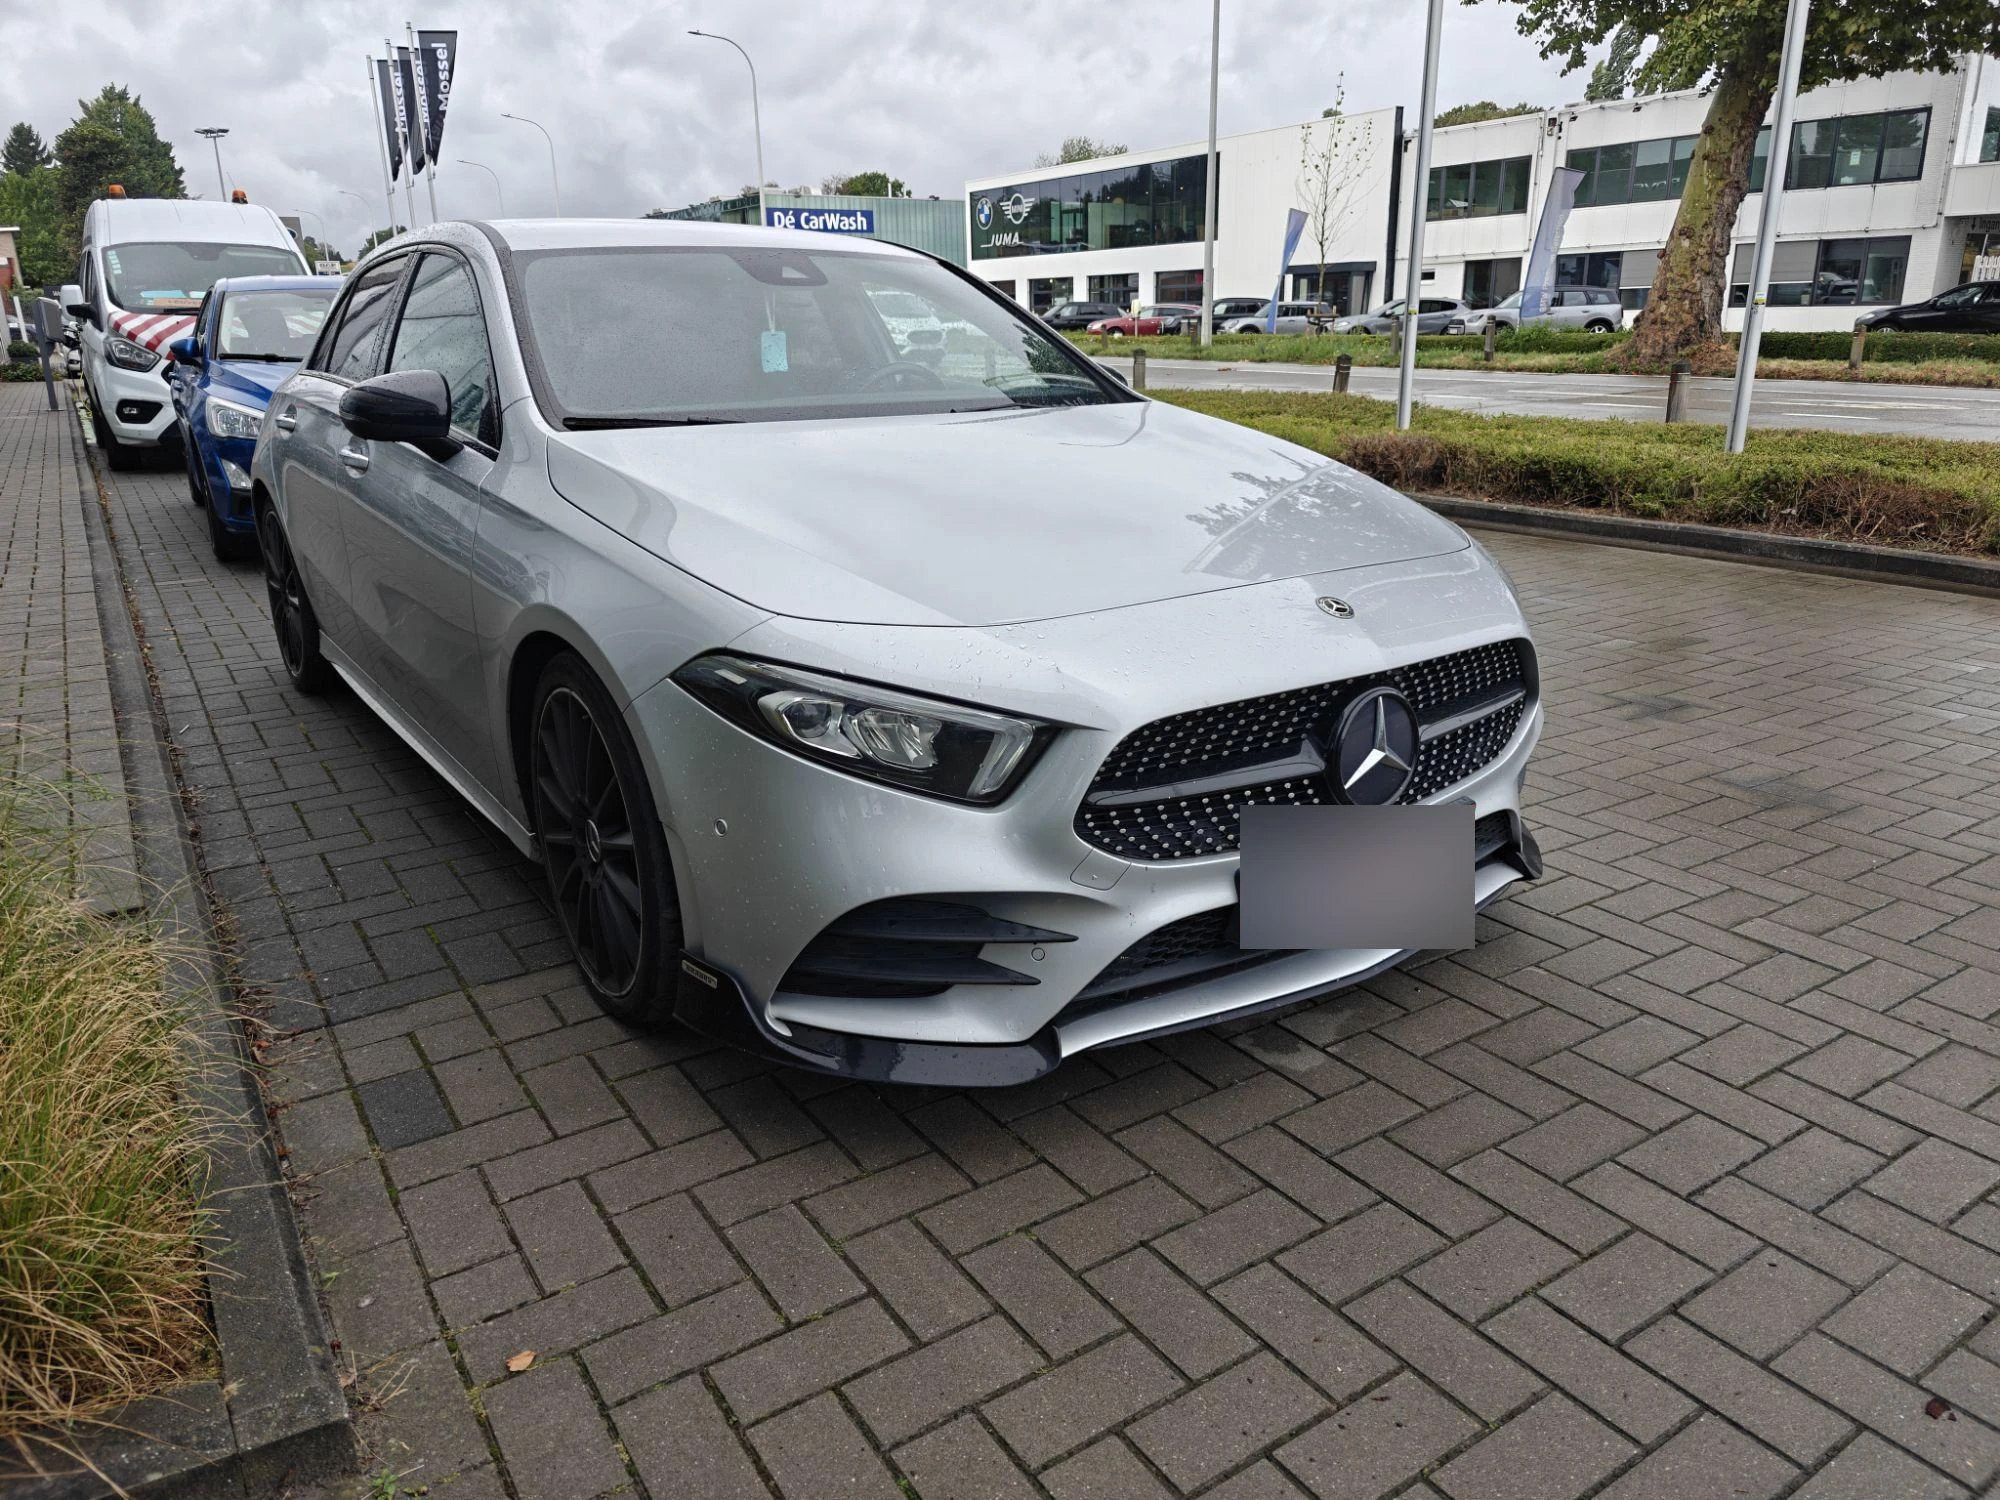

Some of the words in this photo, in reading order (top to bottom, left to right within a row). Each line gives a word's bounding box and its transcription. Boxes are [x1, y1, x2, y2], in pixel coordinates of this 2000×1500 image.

[431, 42, 450, 111] Mossel
[773, 210, 795, 228] Dé
[800, 211, 867, 230] CarWash
[986, 232, 1020, 247] JUMA
